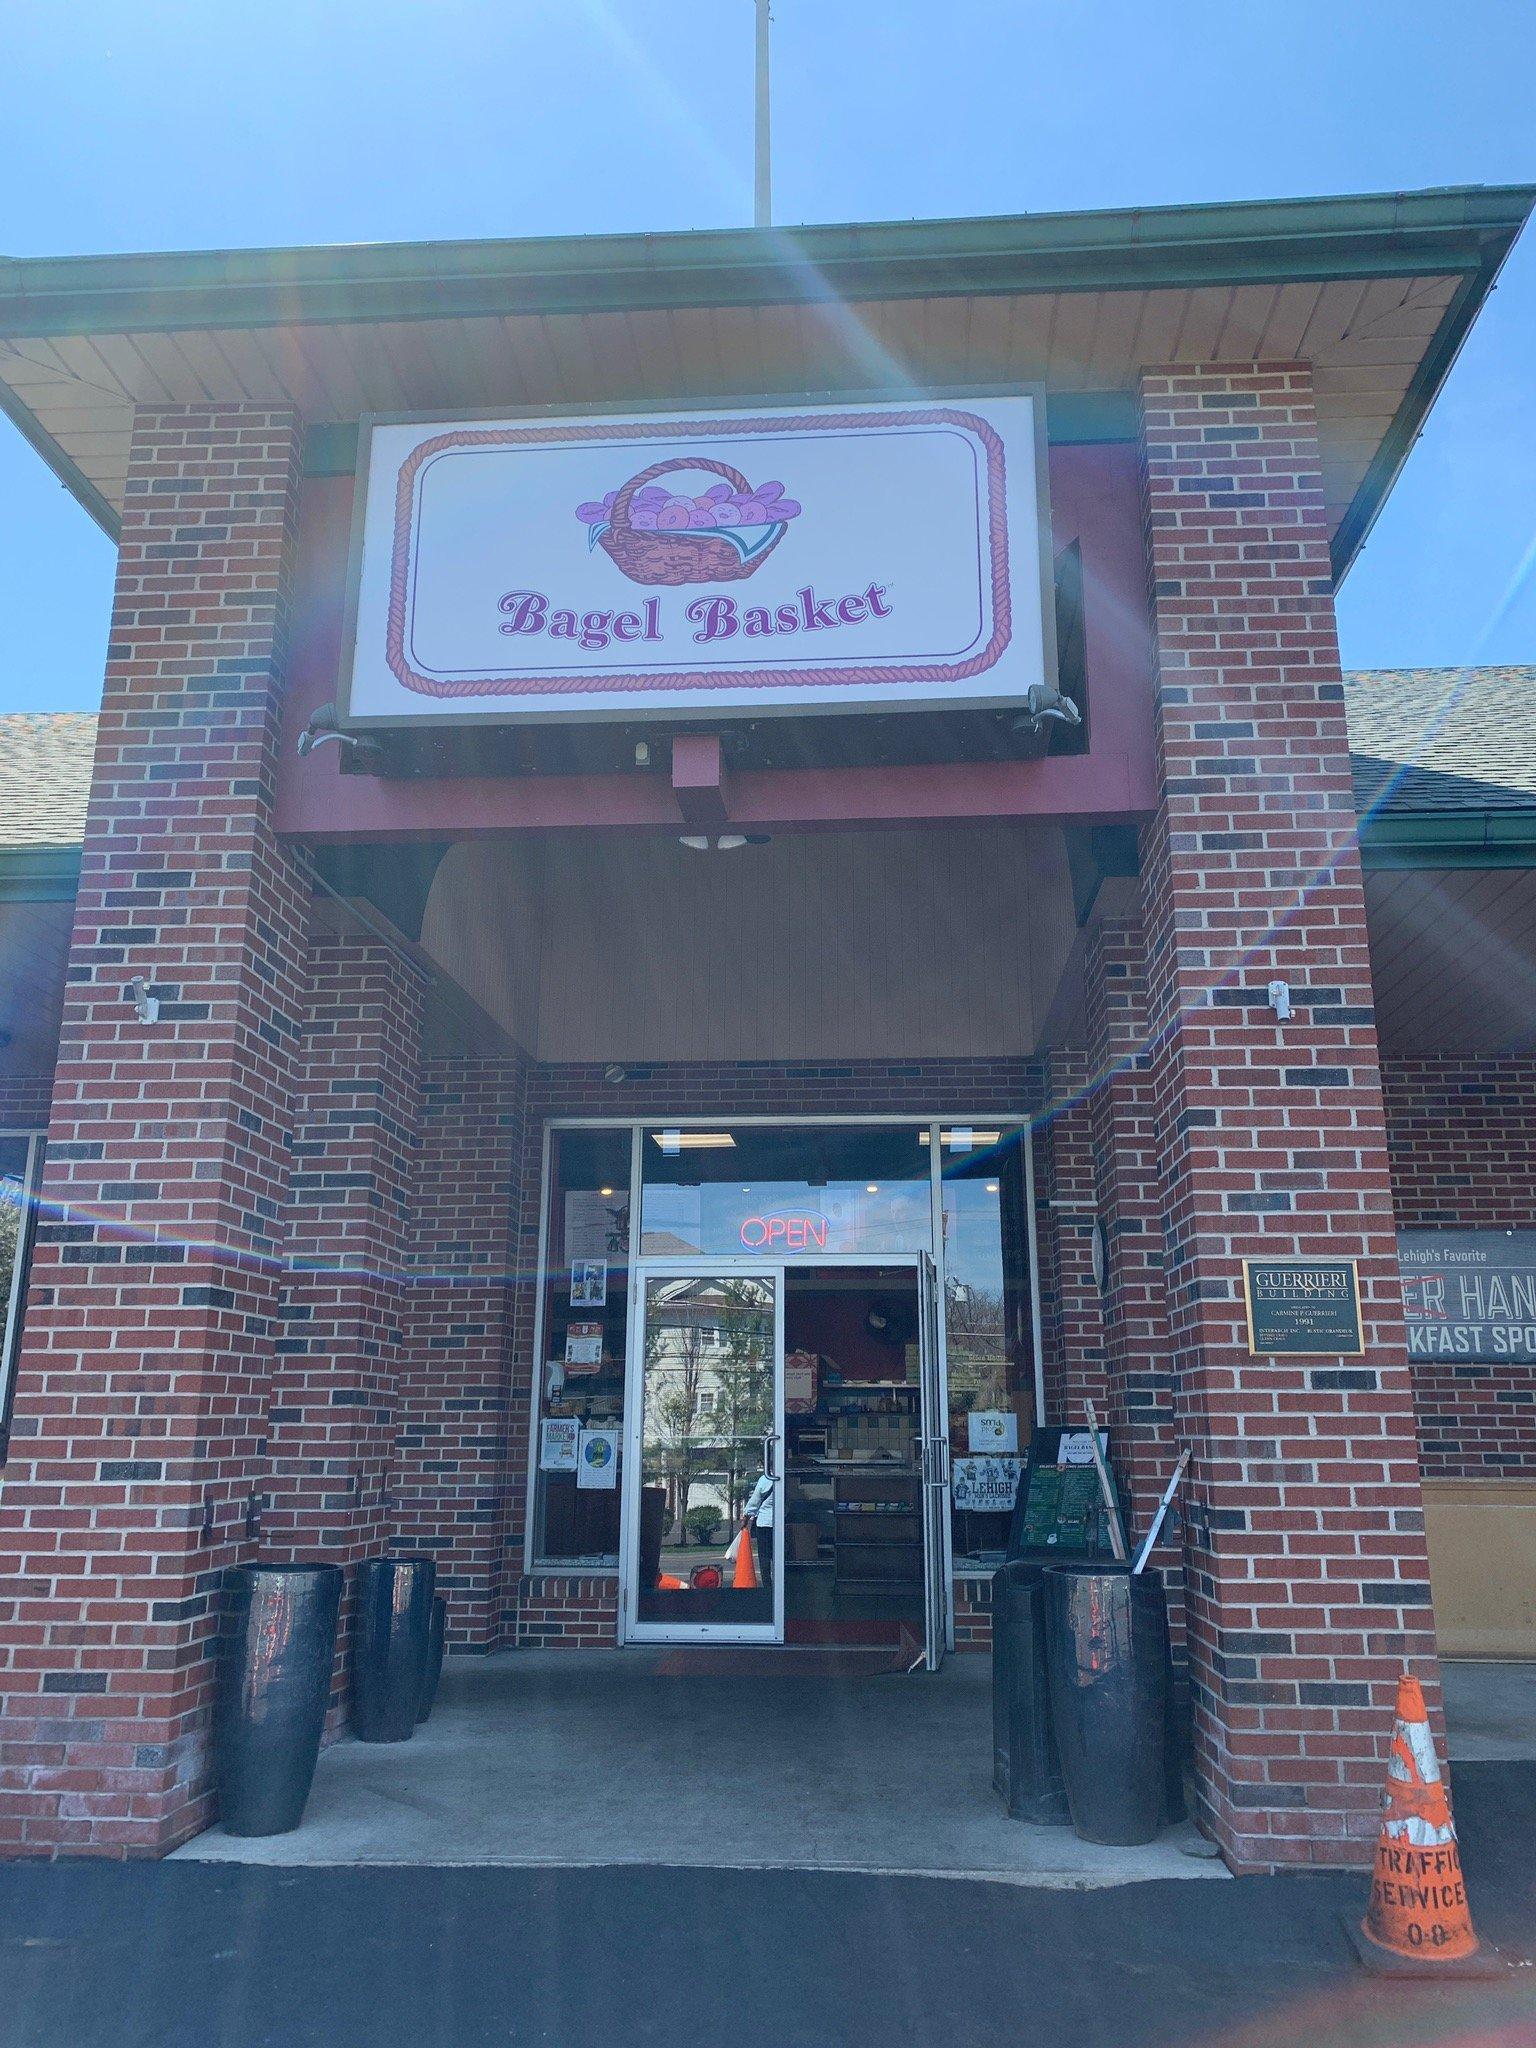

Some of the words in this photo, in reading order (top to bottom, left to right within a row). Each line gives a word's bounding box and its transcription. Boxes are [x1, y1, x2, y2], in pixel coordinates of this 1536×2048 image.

[498, 590, 663, 651] Bagel
[686, 582, 892, 644] Basket
[740, 1217, 826, 1247] OPEN
[1397, 1249, 1440, 1263] Lehigh's
[1444, 1249, 1487, 1261] Favorite
[1256, 1273, 1347, 1288] GUERRIERI
[1257, 1289, 1349, 1298] BUILDING
[1406, 1327, 1482, 1353] KFAST
[972, 1481, 1013, 1493] LEHIGH
[1373, 1880, 1465, 1909] SERVICE
